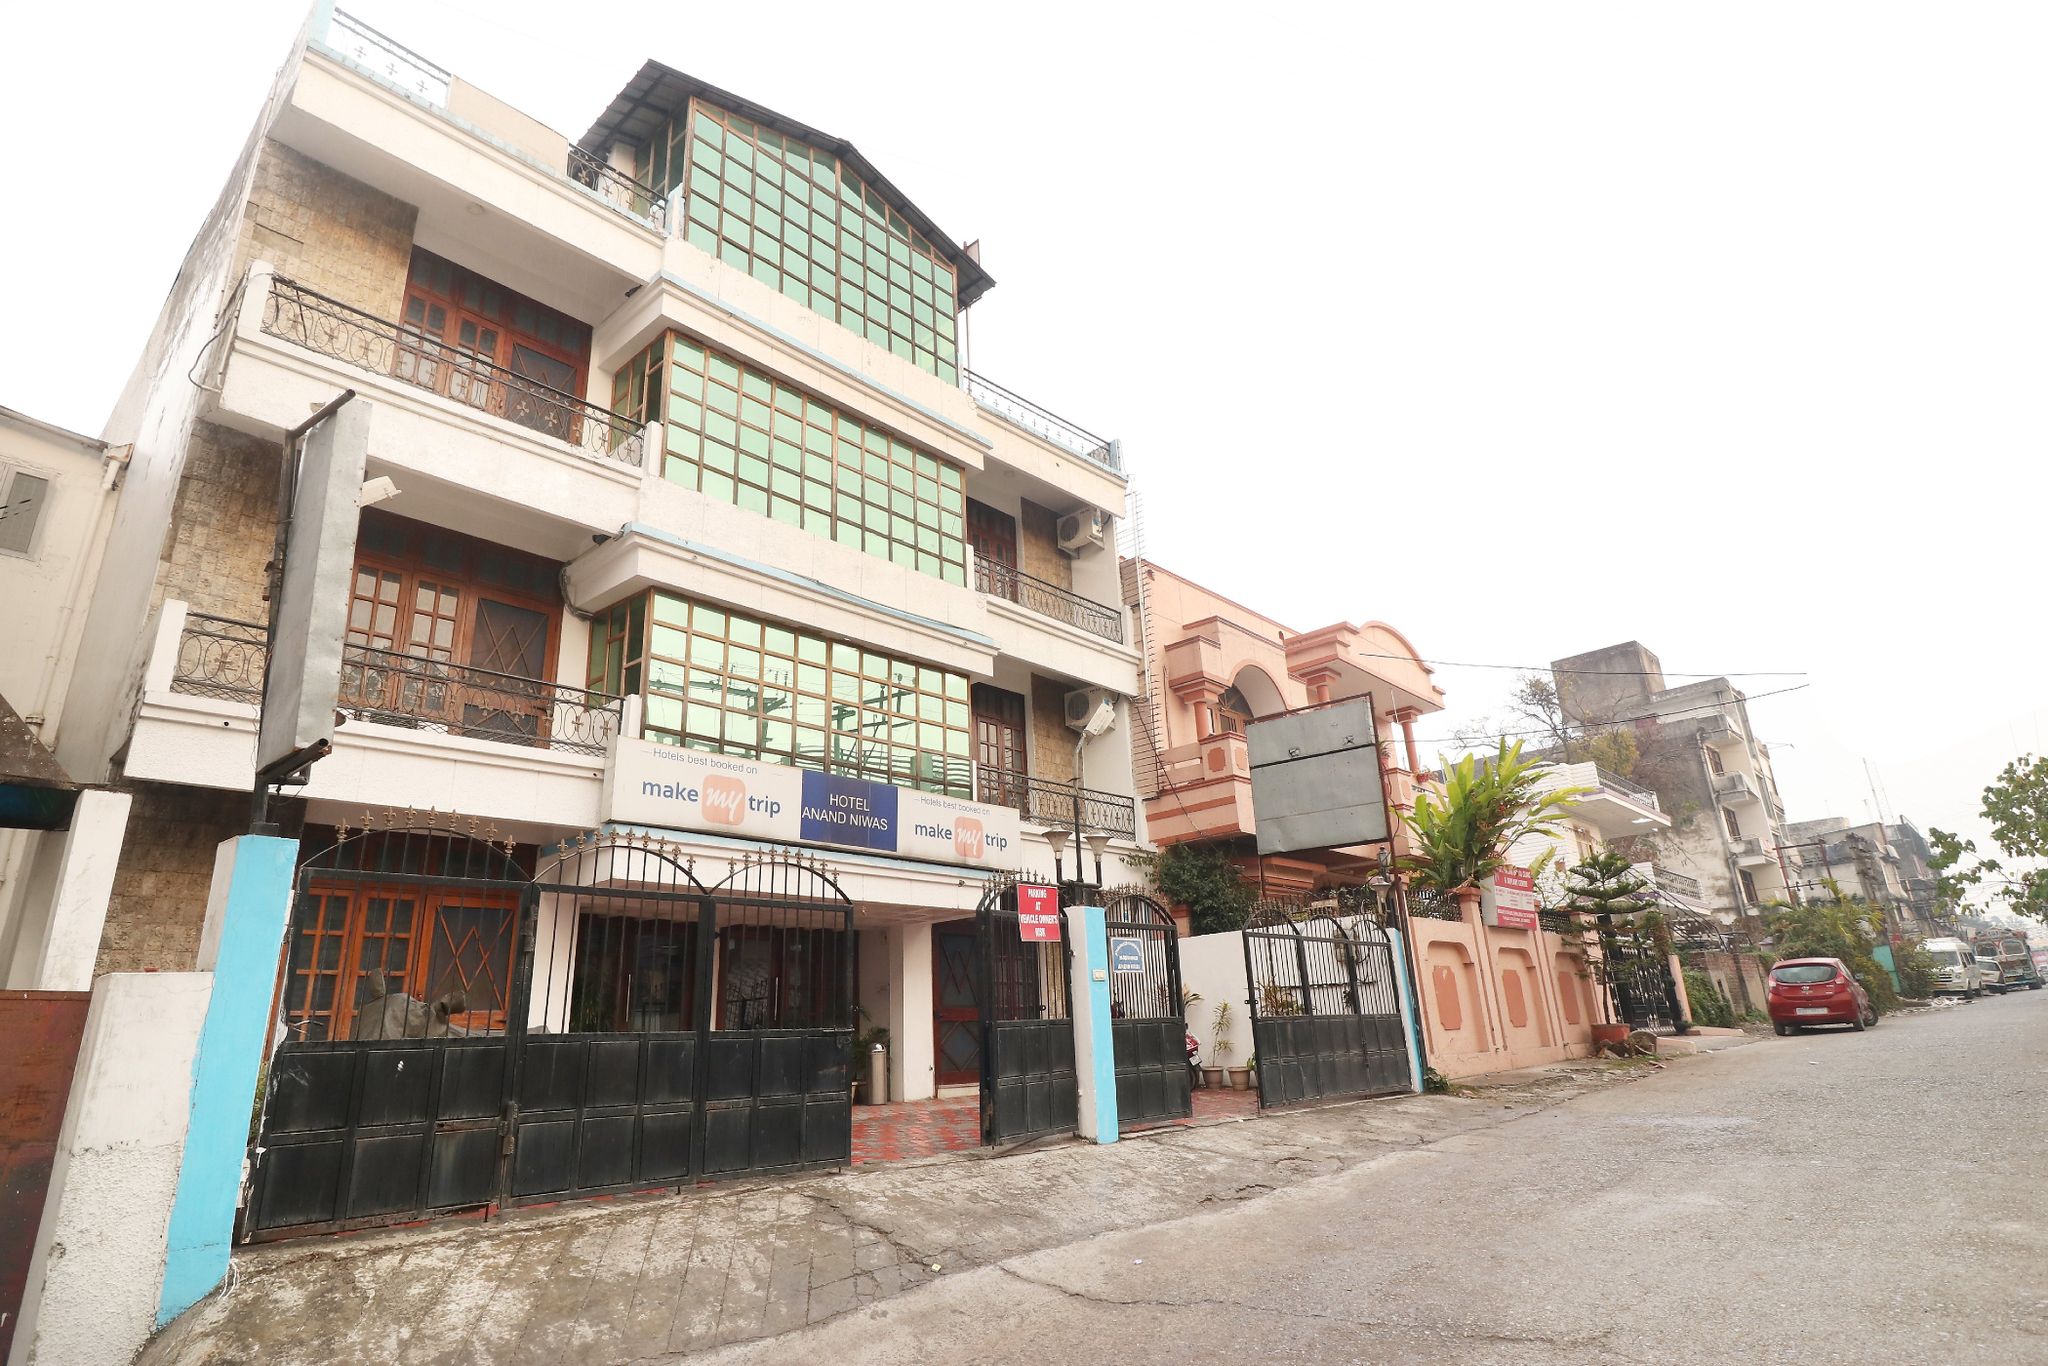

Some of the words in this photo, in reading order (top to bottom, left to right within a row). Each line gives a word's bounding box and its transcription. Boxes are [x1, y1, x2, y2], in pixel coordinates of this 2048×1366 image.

[653, 748, 685, 762] Hotels
[687, 754, 708, 766] best
[710, 758, 744, 773] booked
[746, 766, 758, 775] on
[642, 780, 699, 803] make
[705, 786, 744, 822] my
[748, 794, 781, 818] trip
[829, 793, 870, 812] HOTEL
[920, 796, 942, 808] Hotels
[942, 800, 957, 810] best
[801, 806, 847, 824] ANAND
[849, 813, 888, 831] NIWAS
[914, 823, 953, 840] make
[956, 827, 982, 856] my
[984, 833, 1008, 852] trip
